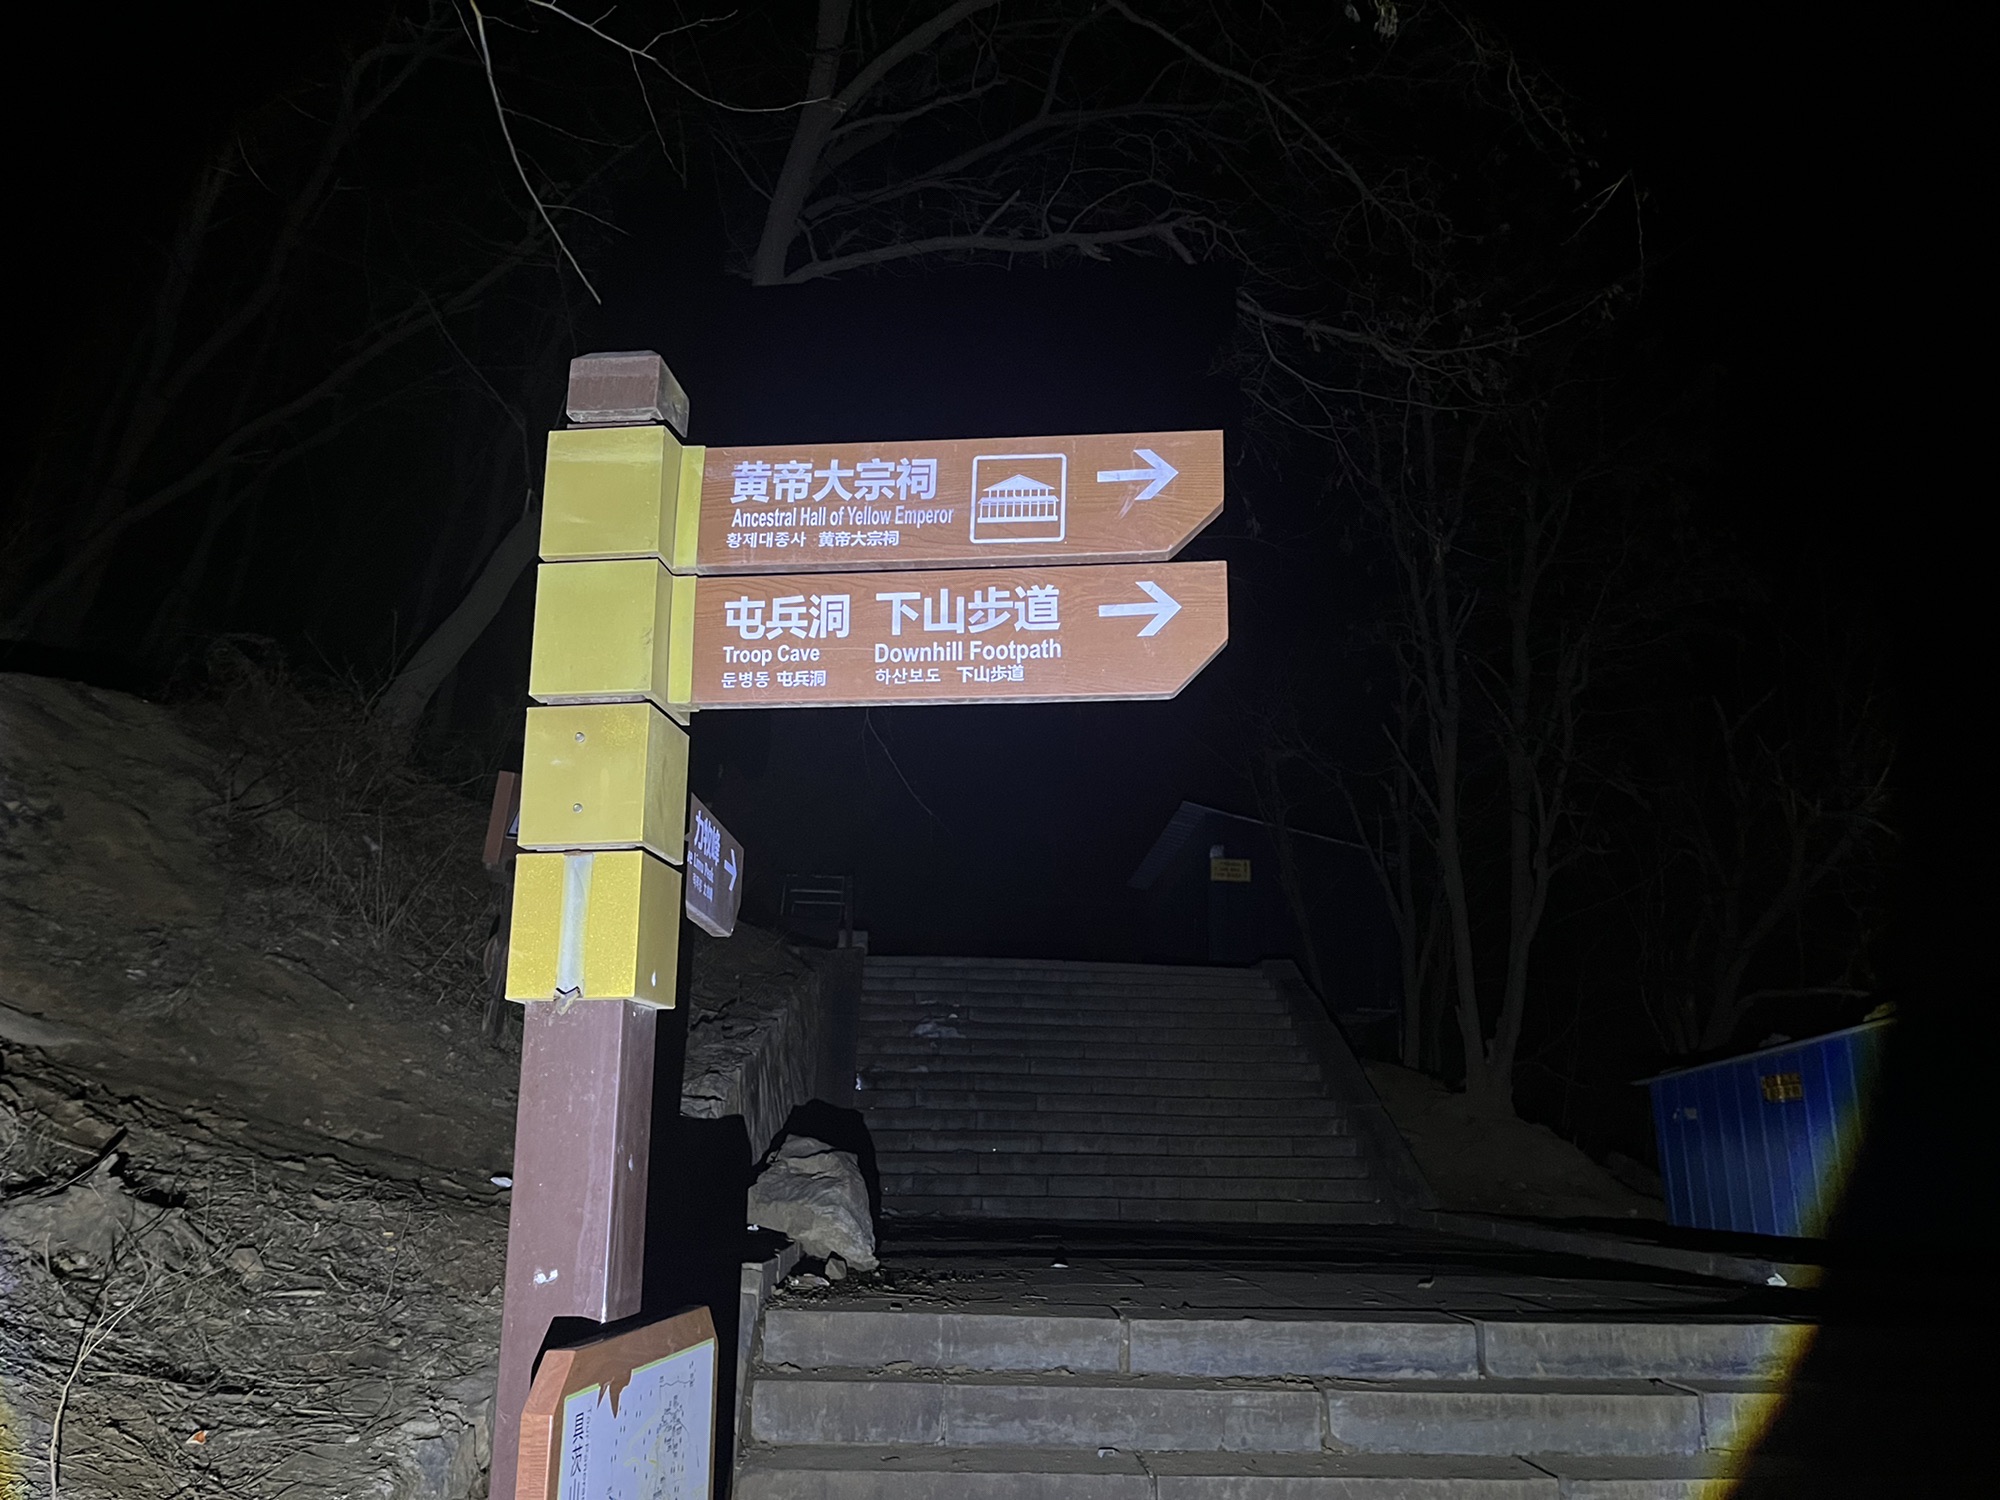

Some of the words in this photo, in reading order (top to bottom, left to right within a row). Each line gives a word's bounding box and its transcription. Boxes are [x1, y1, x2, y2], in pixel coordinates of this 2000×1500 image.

[729, 458, 937, 503] 黄帝大宗祠
[731, 507, 798, 528] Ancestral
[800, 507, 827, 526] Hall
[829, 506, 846, 526] of
[847, 505, 892, 526] Yellow
[894, 505, 955, 529] Emperor
[726, 531, 807, 549] 황제대종사
[818, 530, 900, 548] 黄帝大宗祠
[724, 594, 850, 641] 屯兵洞
[875, 584, 1061, 636] 下山步道
[723, 646, 773, 667] Troop
[777, 644, 821, 663] Cave
[875, 641, 964, 663] Downhill
[970, 638, 1062, 664] Footpath
[721, 671, 771, 689] 둔병동
[776, 670, 827, 688] 屯兵洞
[875, 667, 942, 686] 하산보도
